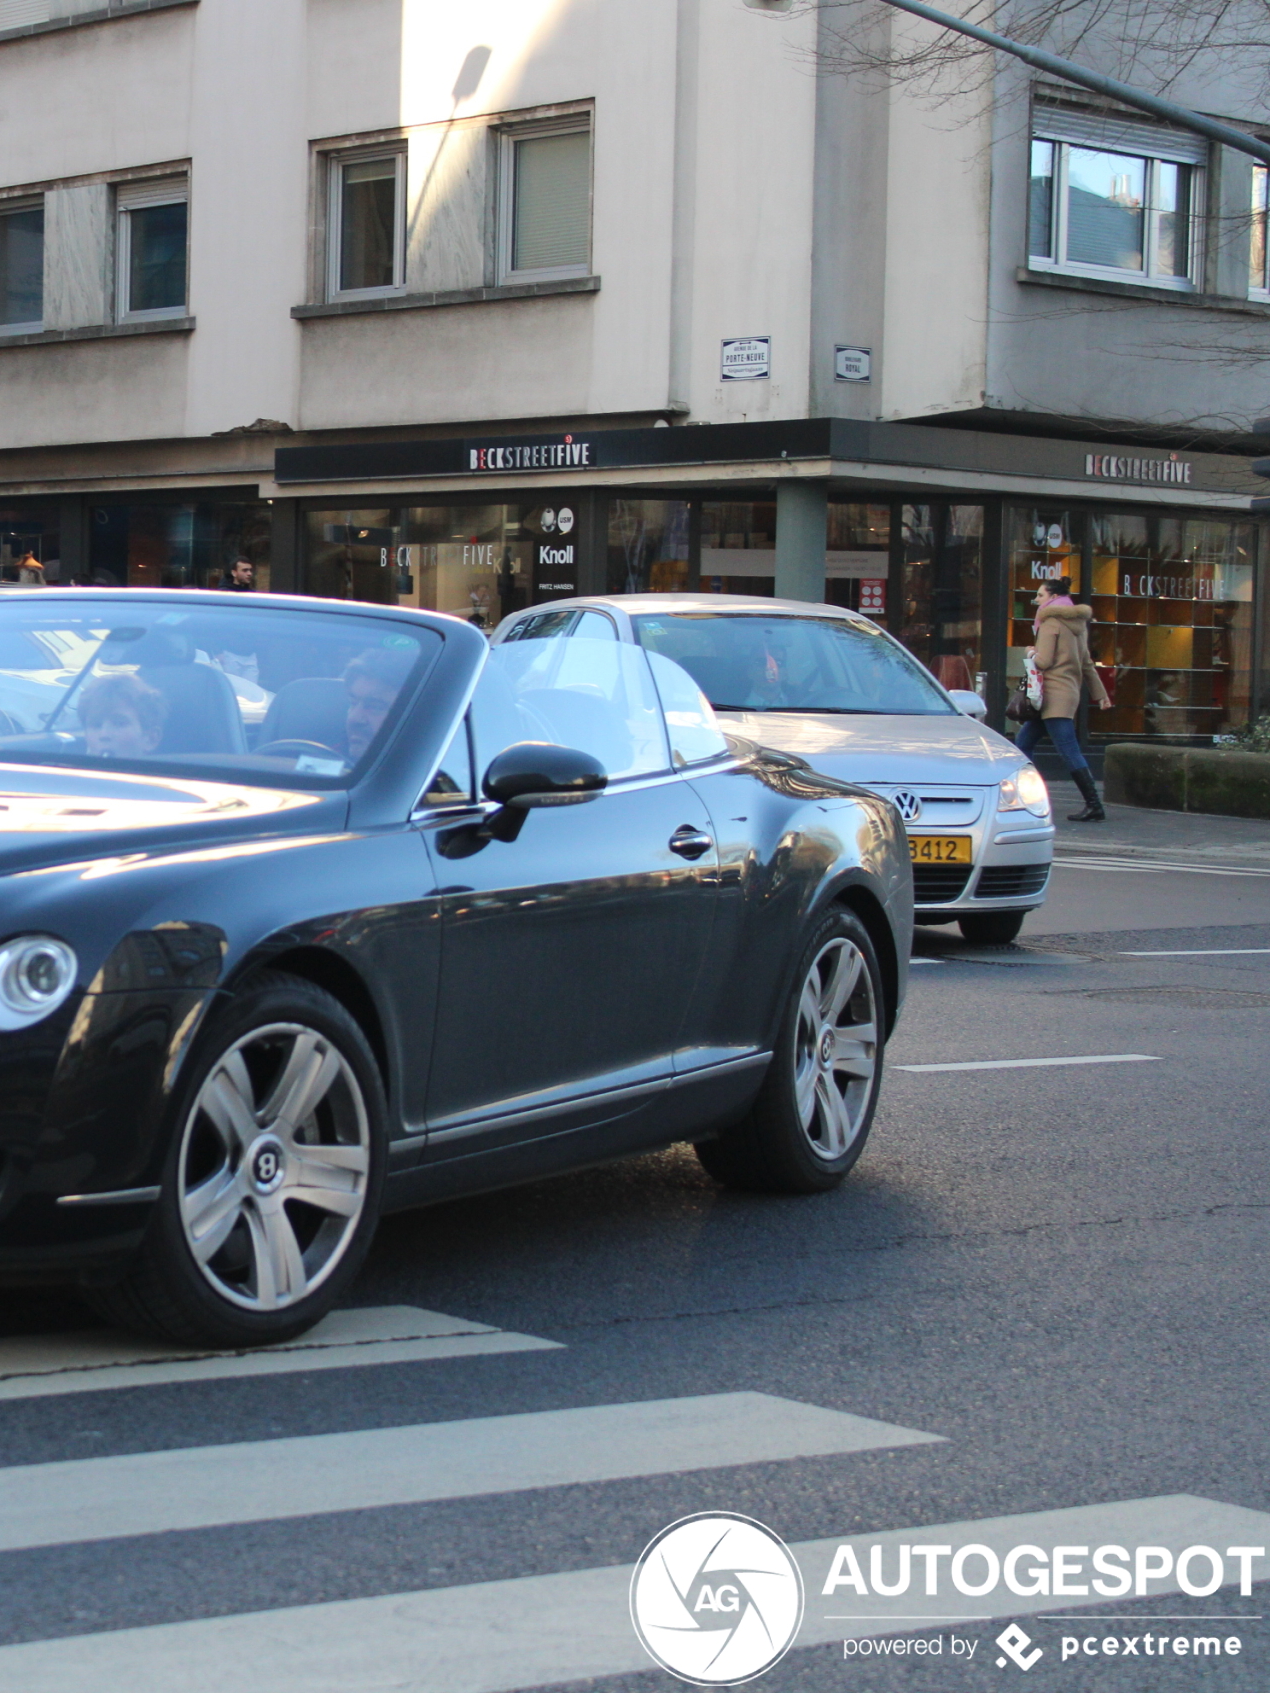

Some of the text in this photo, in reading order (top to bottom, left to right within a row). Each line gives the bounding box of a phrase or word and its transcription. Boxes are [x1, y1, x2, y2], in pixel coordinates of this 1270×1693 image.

[726, 352, 765, 363] PORTE-NEUVE
[845, 363, 861, 374] ROYAL
[469, 435, 590, 470] BECKSTREETFIVE
[1085, 453, 1191, 484] BECKSTREETFIVE
[539, 545, 574, 564] Knoll
[1031, 560, 1062, 580] Knoll
[538, 583, 553, 591] FRITZ
